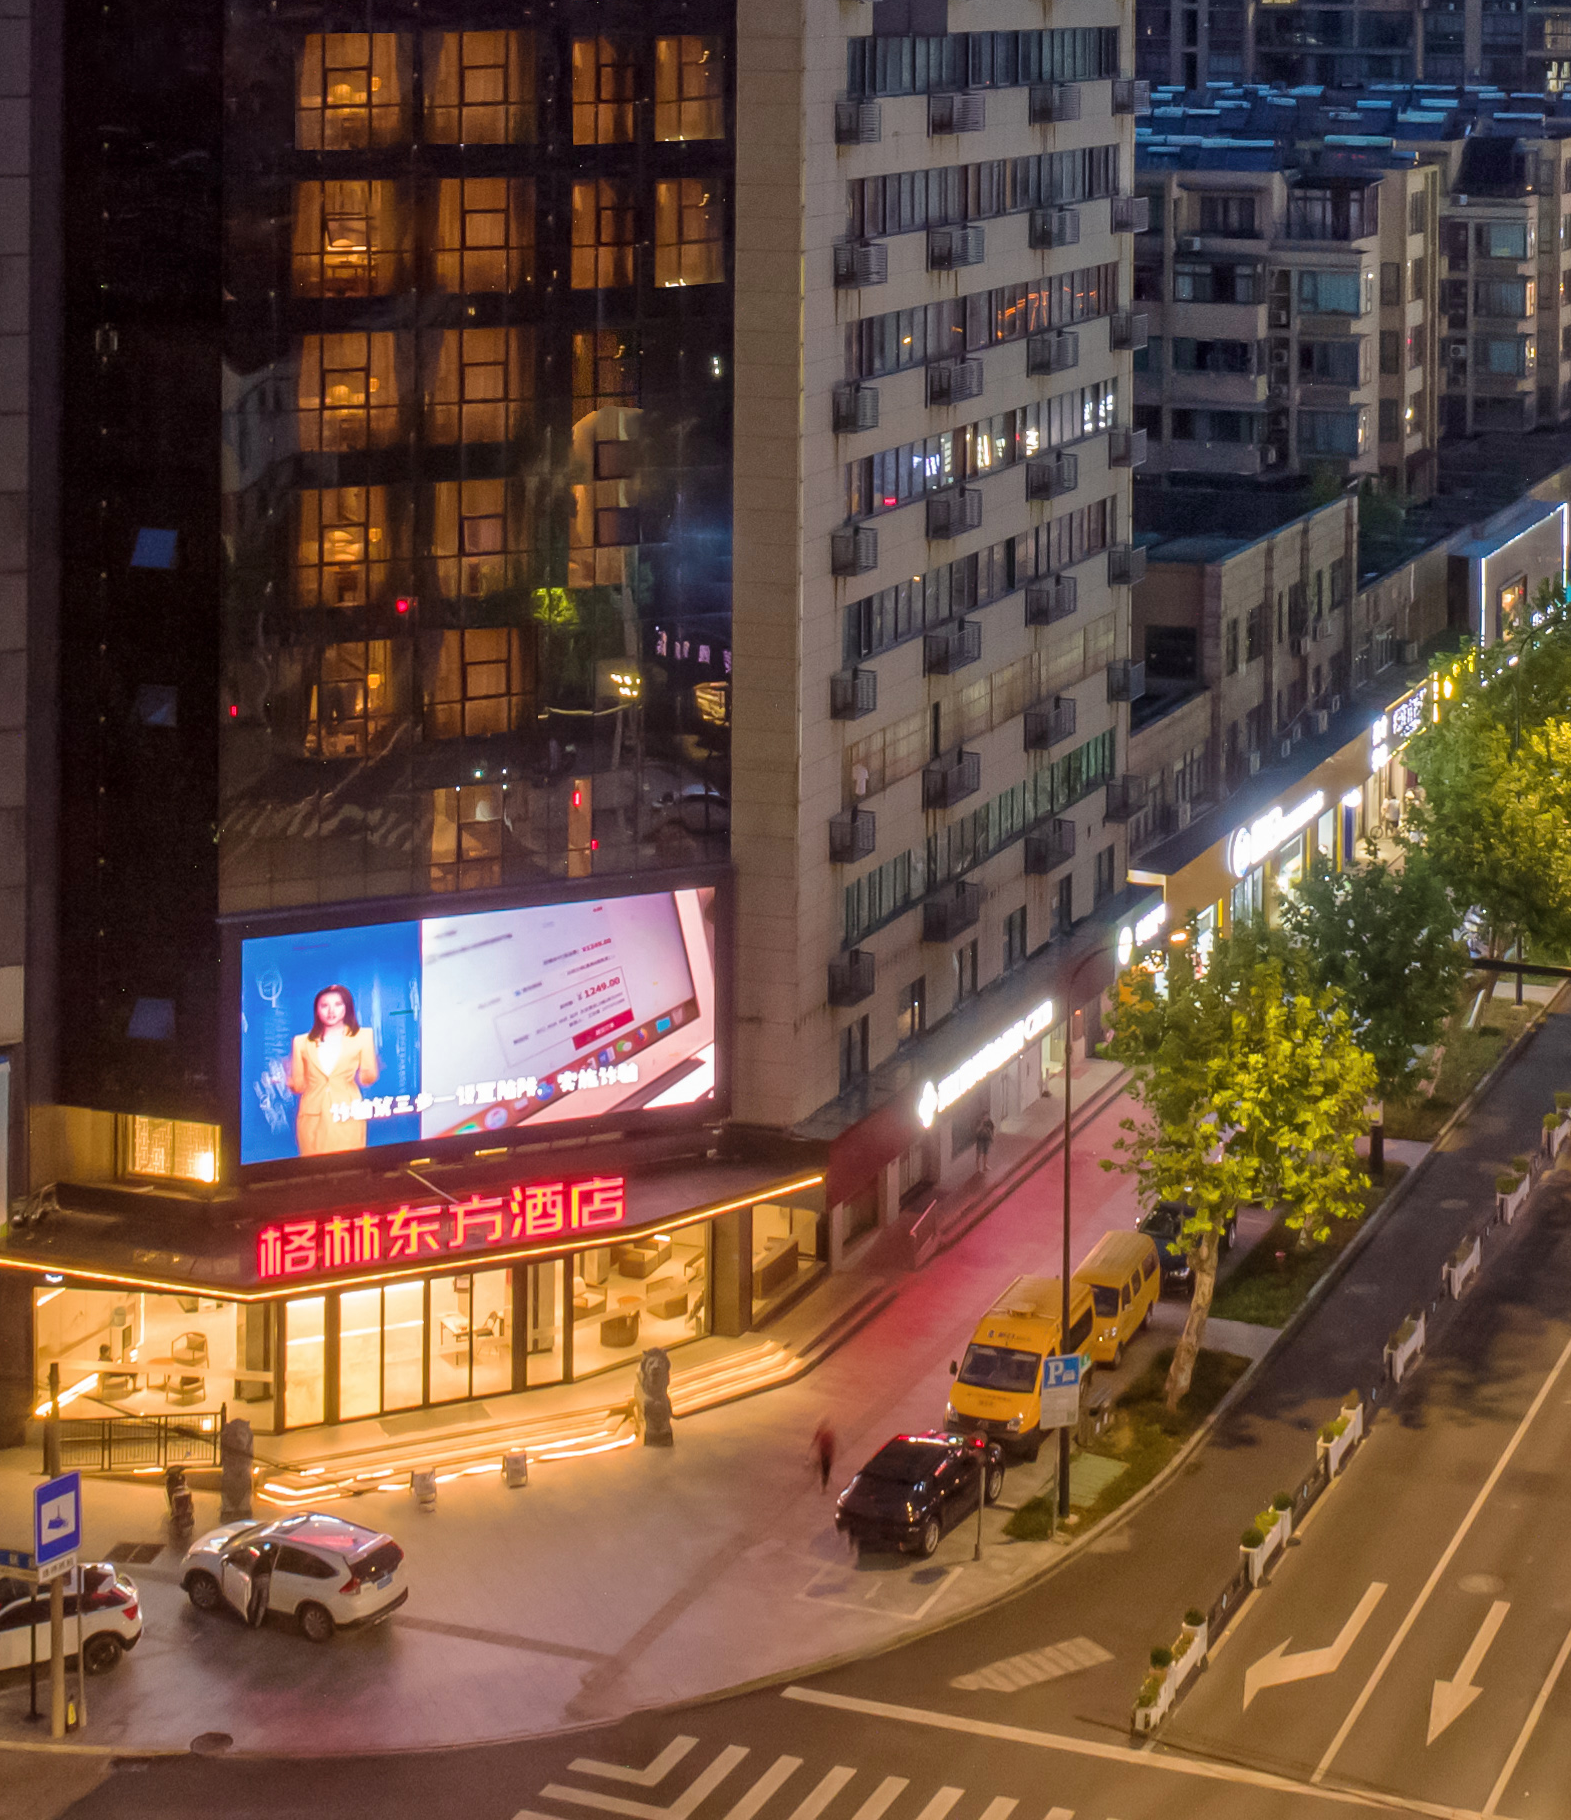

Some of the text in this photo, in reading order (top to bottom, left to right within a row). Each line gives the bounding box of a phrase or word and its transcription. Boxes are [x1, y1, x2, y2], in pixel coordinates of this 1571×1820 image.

[258, 1177, 626, 1278] 格林东方酒店
[1047, 1360, 1065, 1385] P
